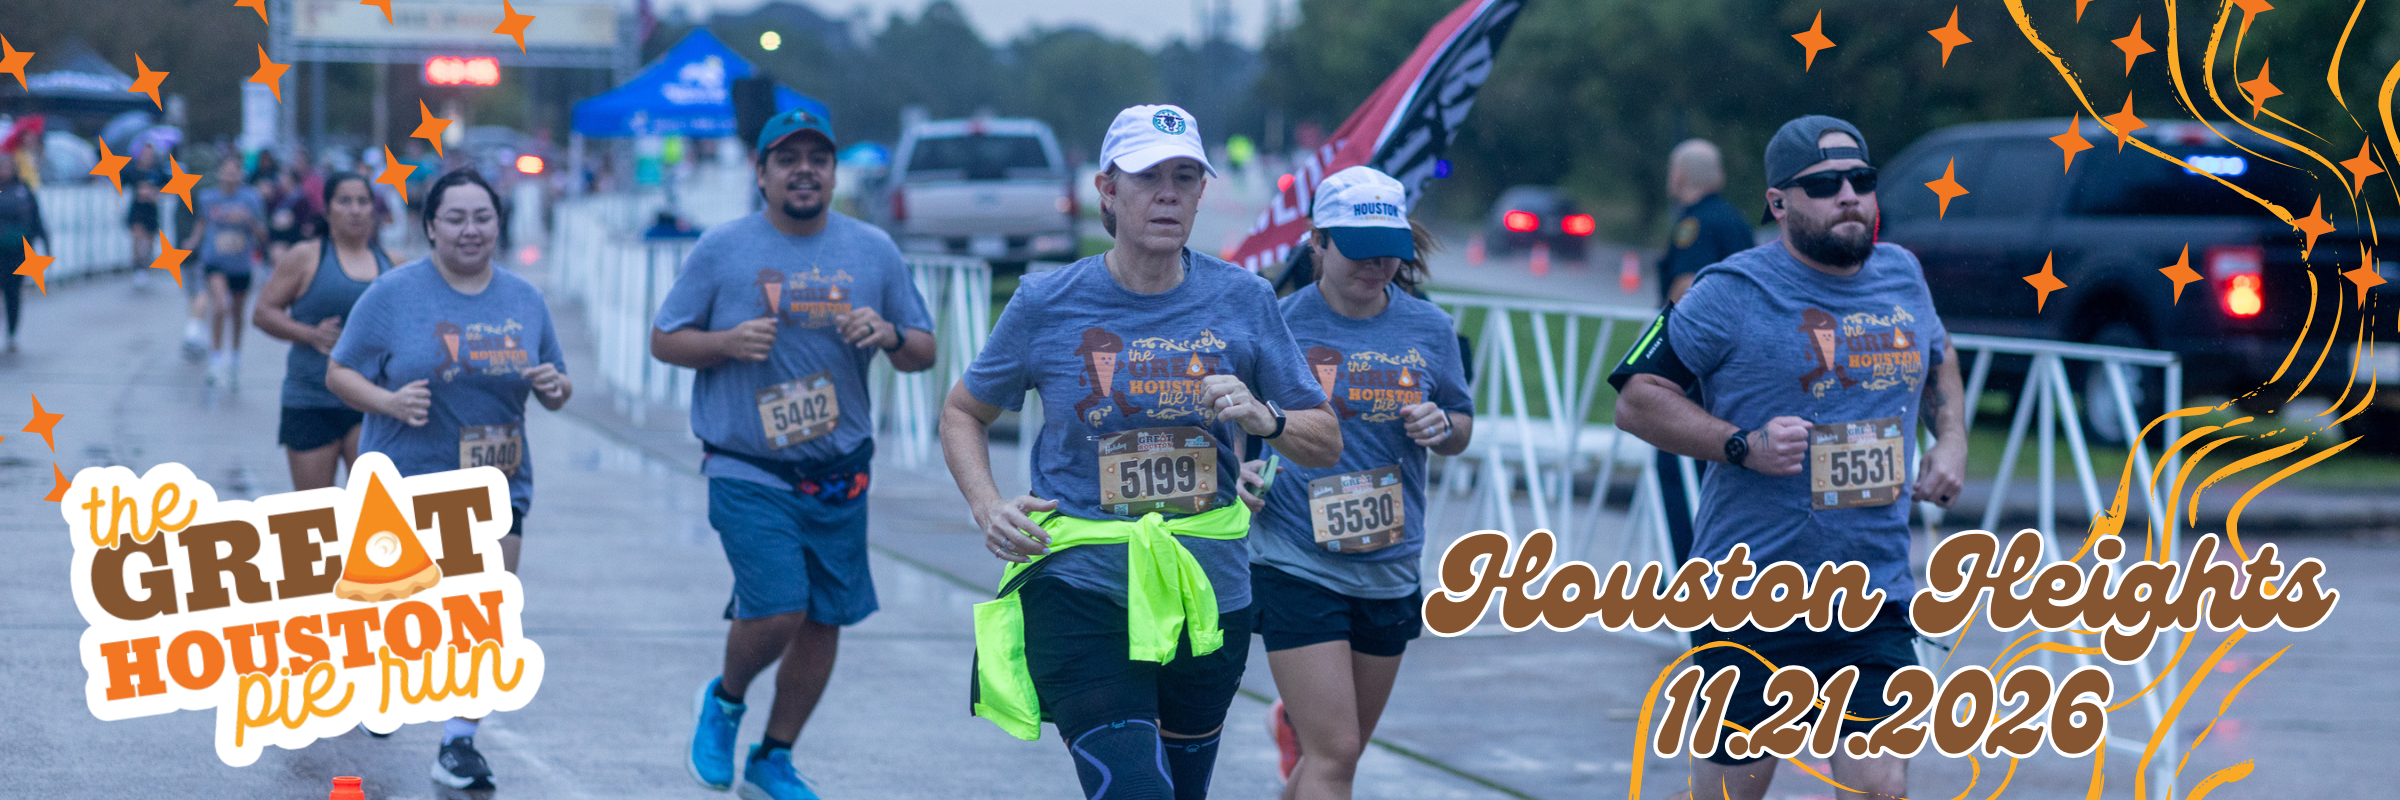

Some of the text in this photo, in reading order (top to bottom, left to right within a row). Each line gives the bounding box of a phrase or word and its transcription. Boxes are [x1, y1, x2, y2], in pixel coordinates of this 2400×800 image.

[1353, 202, 1399, 218] HOUSTON
[1843, 325, 1865, 338] the
[1846, 325, 1917, 352] GREAT
[1128, 348, 1155, 362] the
[1848, 351, 1921, 368] HOUSTON
[1128, 351, 1220, 380] GREAT
[1347, 360, 1371, 373] the
[1348, 366, 1421, 389] GREAT
[1129, 380, 1202, 395] HOUST
[1348, 388, 1422, 404] HOUSTON
[1158, 391, 1187, 408] pie
[772, 394, 830, 431] 5442
[1138, 431, 1174, 444] GREAT
[471, 441, 517, 468] 5440
[1831, 446, 1894, 487] 5531
[1120, 455, 1196, 499] 5199
[1326, 493, 1394, 536] 5530
